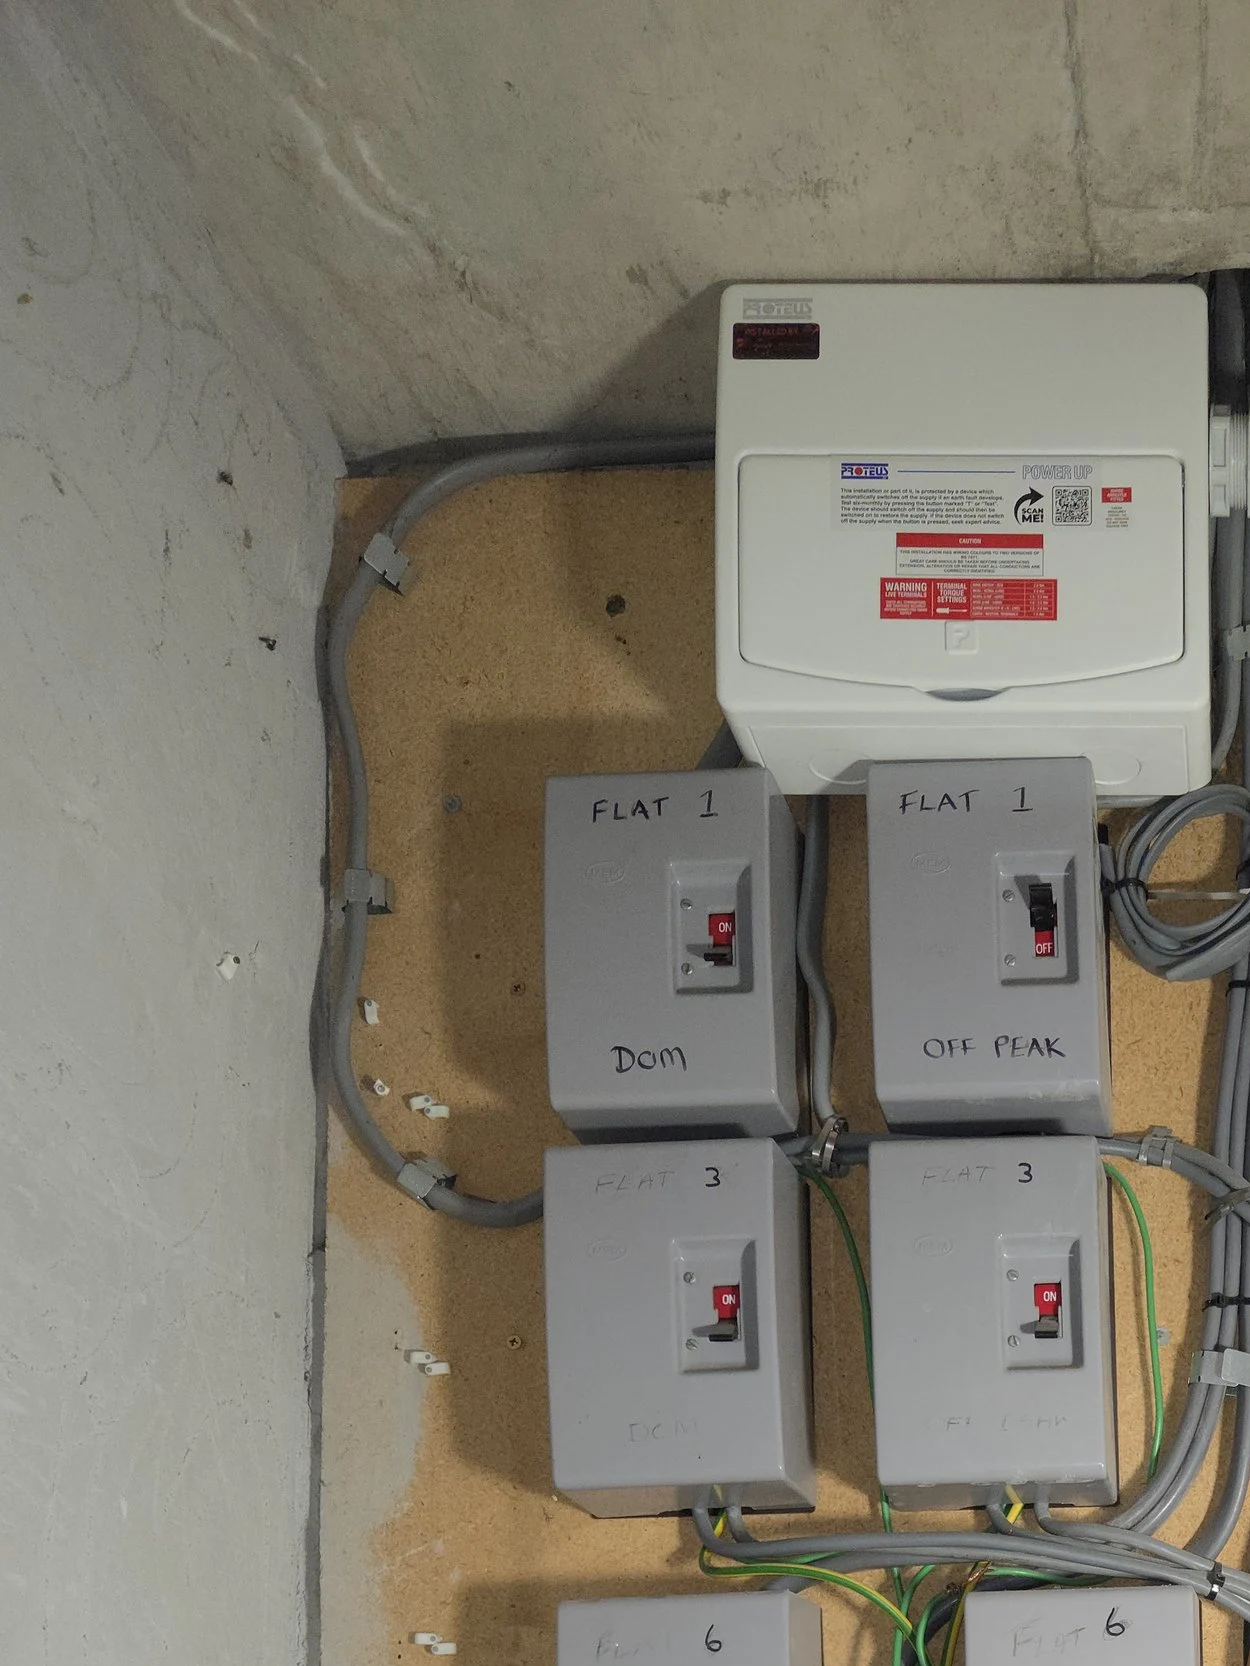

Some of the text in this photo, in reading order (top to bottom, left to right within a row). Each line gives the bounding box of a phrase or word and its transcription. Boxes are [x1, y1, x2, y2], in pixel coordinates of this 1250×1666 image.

[841, 463, 889, 479] PROTEUS
[1022, 465, 1093, 480] POWER UP
[1021, 514, 1044, 523] ME!
[958, 537, 982, 545] CAUTION
[885, 582, 927, 592] WARNING
[592, 790, 719, 822] FLAT 1
[900, 787, 1034, 815] FLAT 1
[718, 920, 733, 934] ON
[1035, 941, 1053, 956] OFF
[923, 1035, 1066, 1059] OFF PEAK
[614, 1045, 688, 1074] DOM
[705, 1166, 721, 1188] 3
[1018, 1162, 1034, 1184] 3
[721, 1293, 736, 1305] ON
[1042, 1290, 1058, 1302] ON
[1104, 1607, 1125, 1637] 6
[705, 1624, 722, 1653] 6
